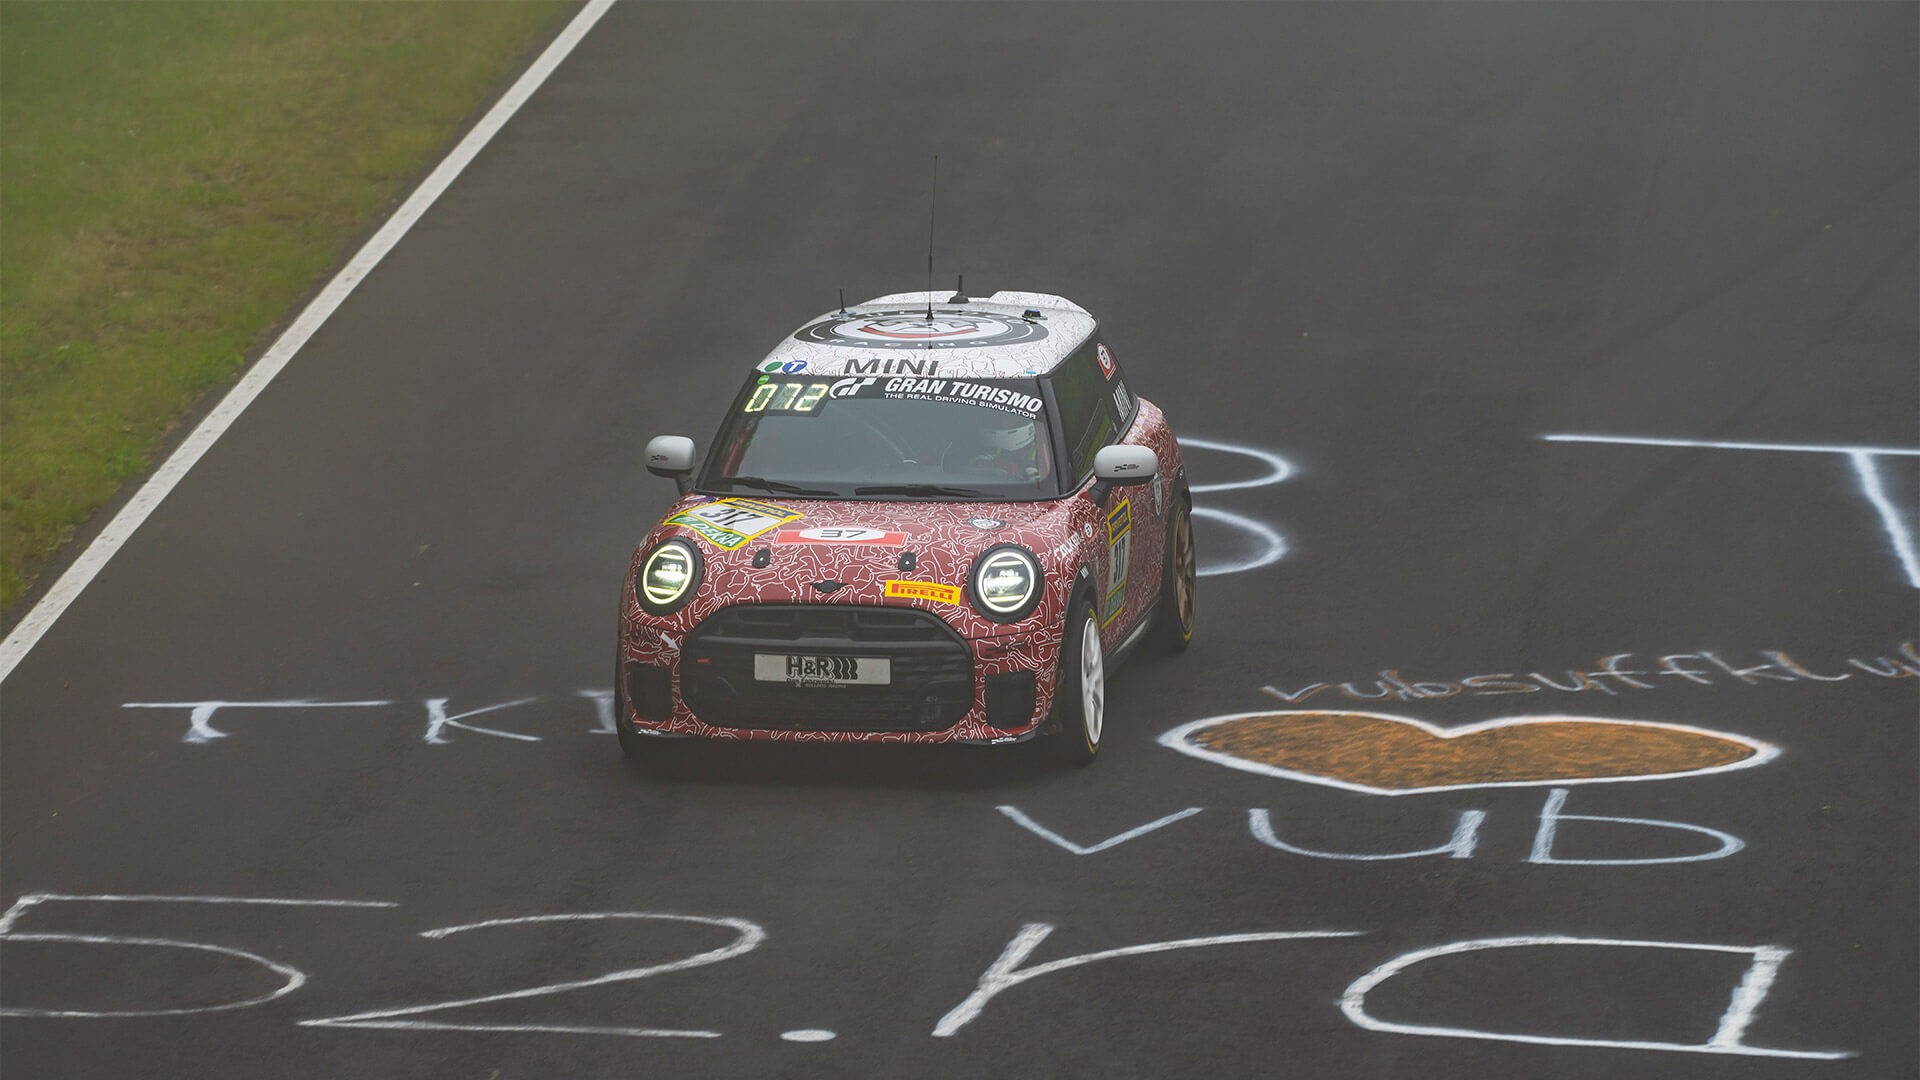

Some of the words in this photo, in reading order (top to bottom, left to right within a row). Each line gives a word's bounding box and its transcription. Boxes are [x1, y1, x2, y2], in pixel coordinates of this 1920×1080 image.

[843, 358, 939, 376] MINI
[744, 383, 829, 412] 072
[885, 377, 947, 395] GRAN
[950, 381, 1043, 412] TURISMO
[907, 393, 932, 401] REAL
[935, 395, 976, 406] DRIVING
[979, 400, 1037, 420] SIMULATOR
[700, 508, 764, 526] 317
[693, 522, 743, 548] DEKRA
[820, 528, 867, 539] 37
[891, 583, 954, 601] PIRELLI
[786, 655, 833, 678] H&R
[995, 788, 1748, 866] vub
